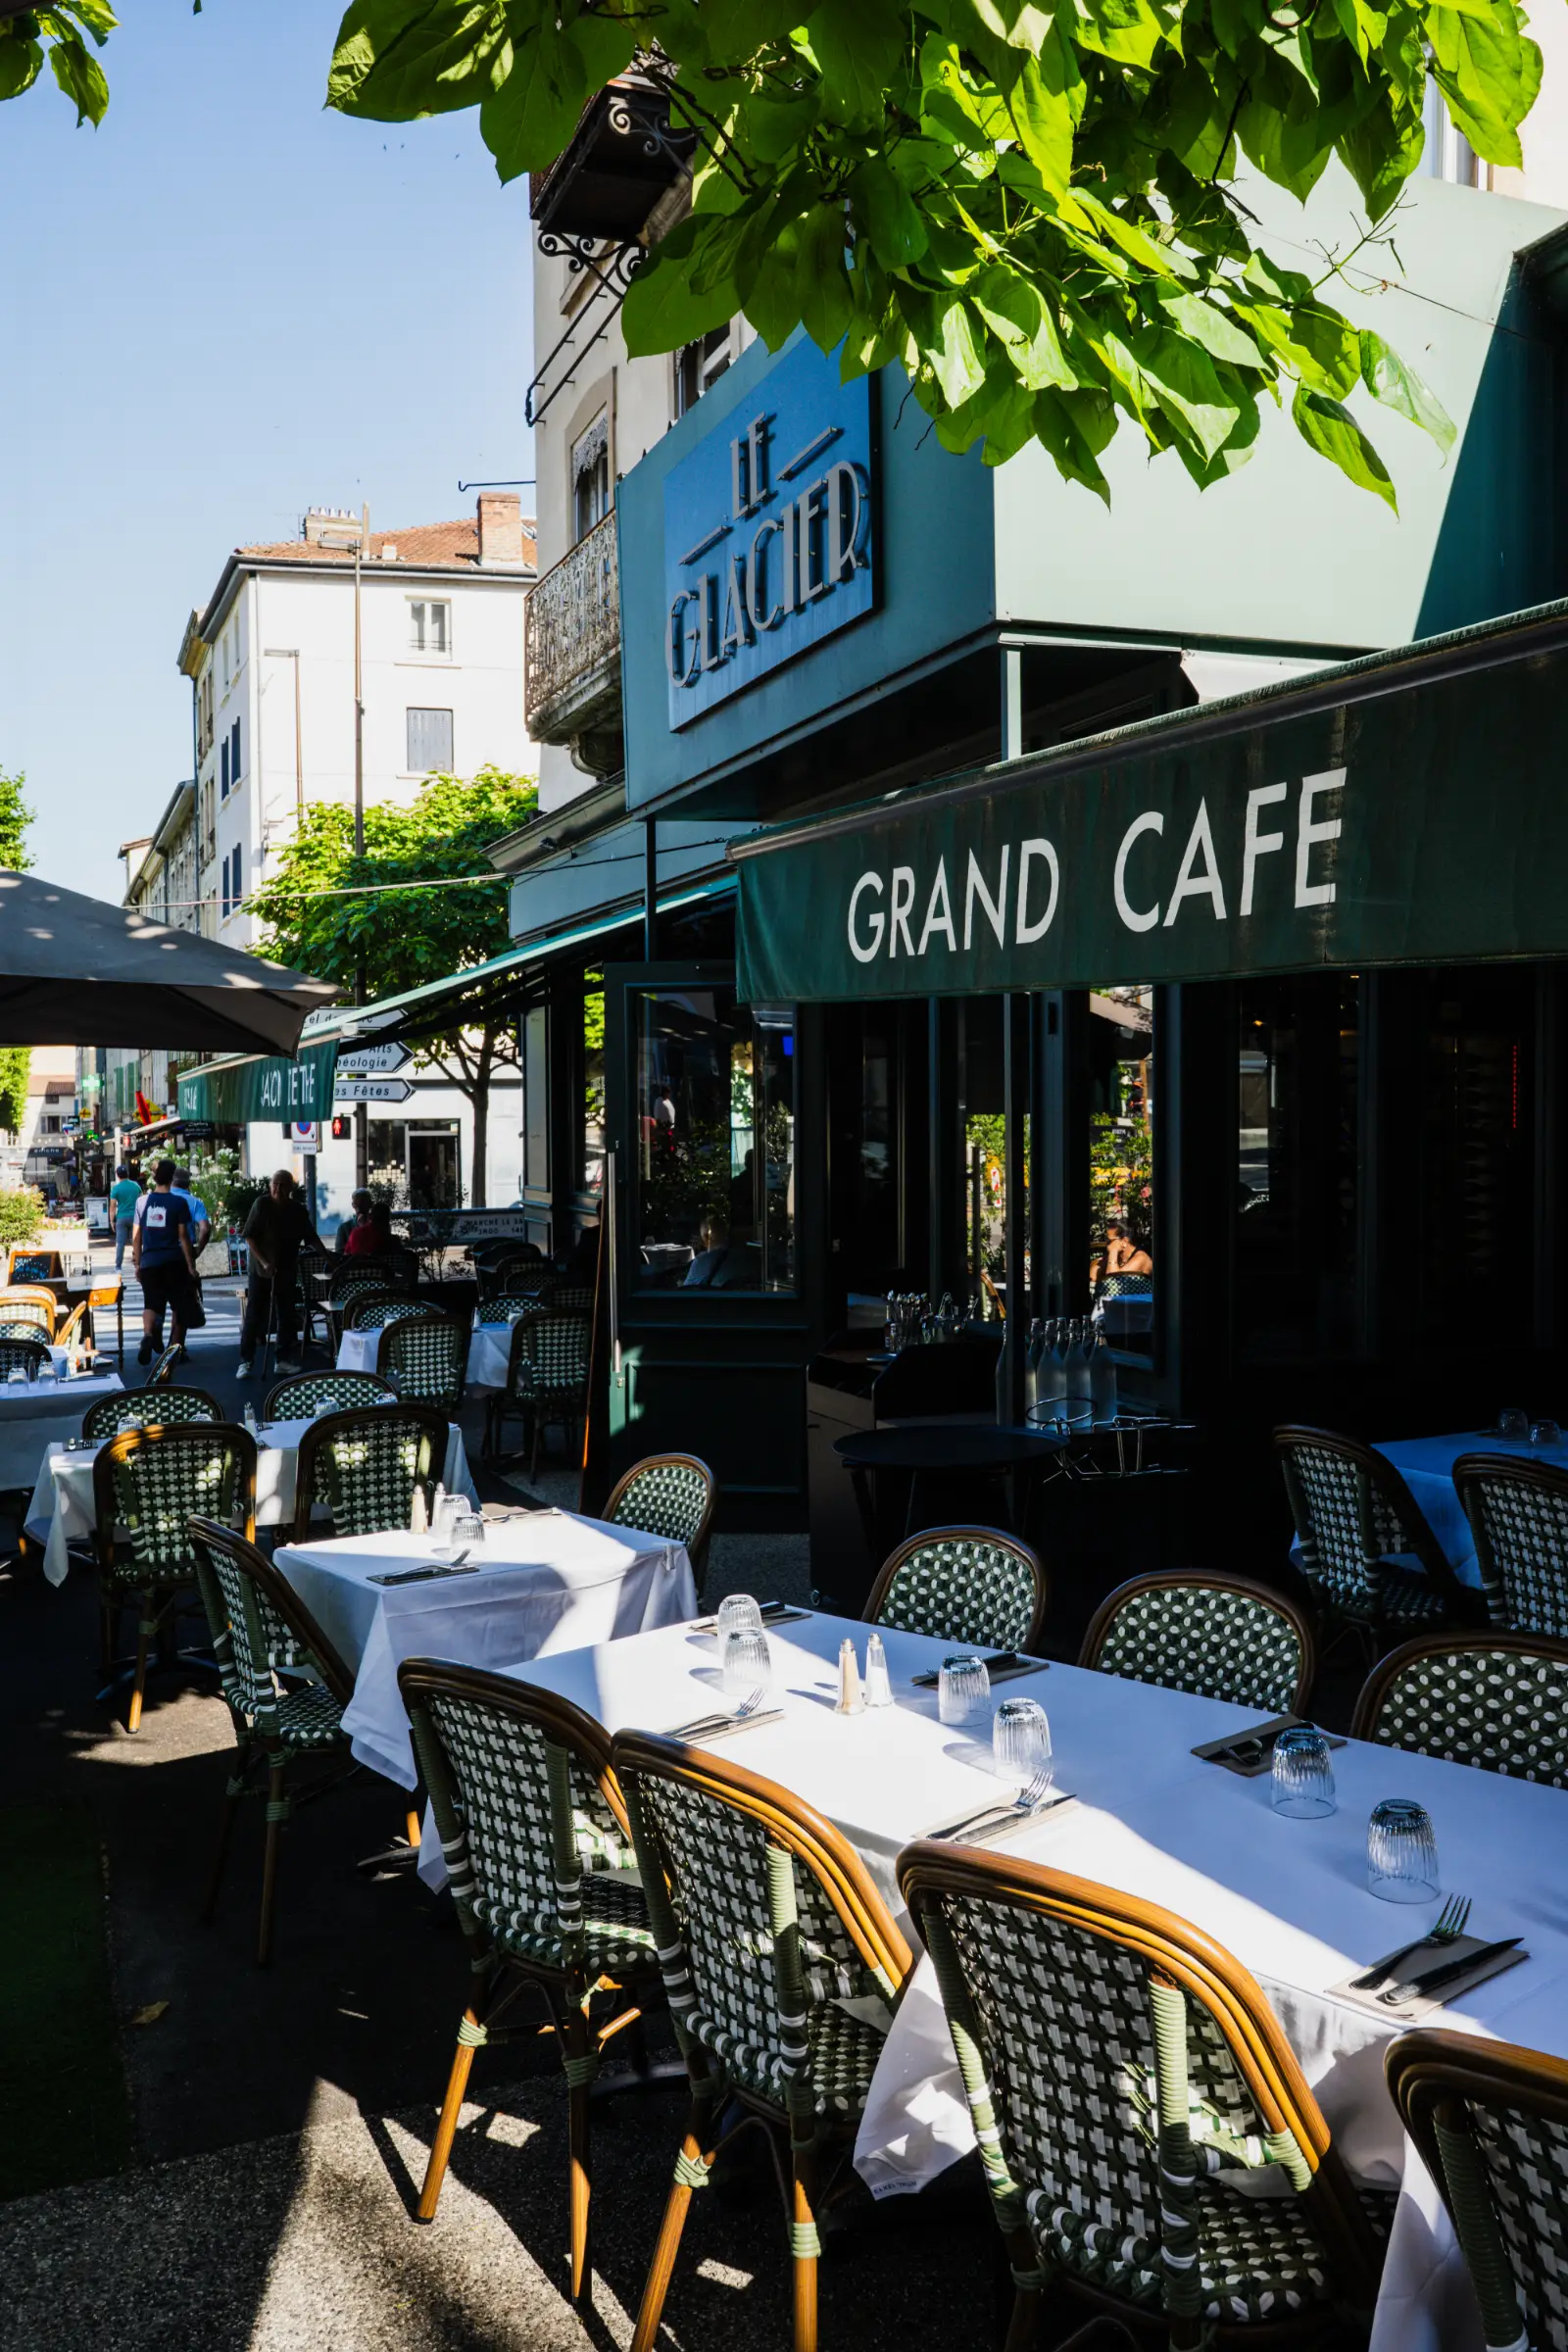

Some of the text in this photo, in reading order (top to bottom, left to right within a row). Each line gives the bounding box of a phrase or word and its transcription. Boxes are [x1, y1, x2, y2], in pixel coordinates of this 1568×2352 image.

[729, 412, 766, 521] LE
[665, 461, 861, 688] GLACIER
[848, 767, 1347, 962] GRAND CAFE
[354, 1085, 390, 1096] Fêtes
